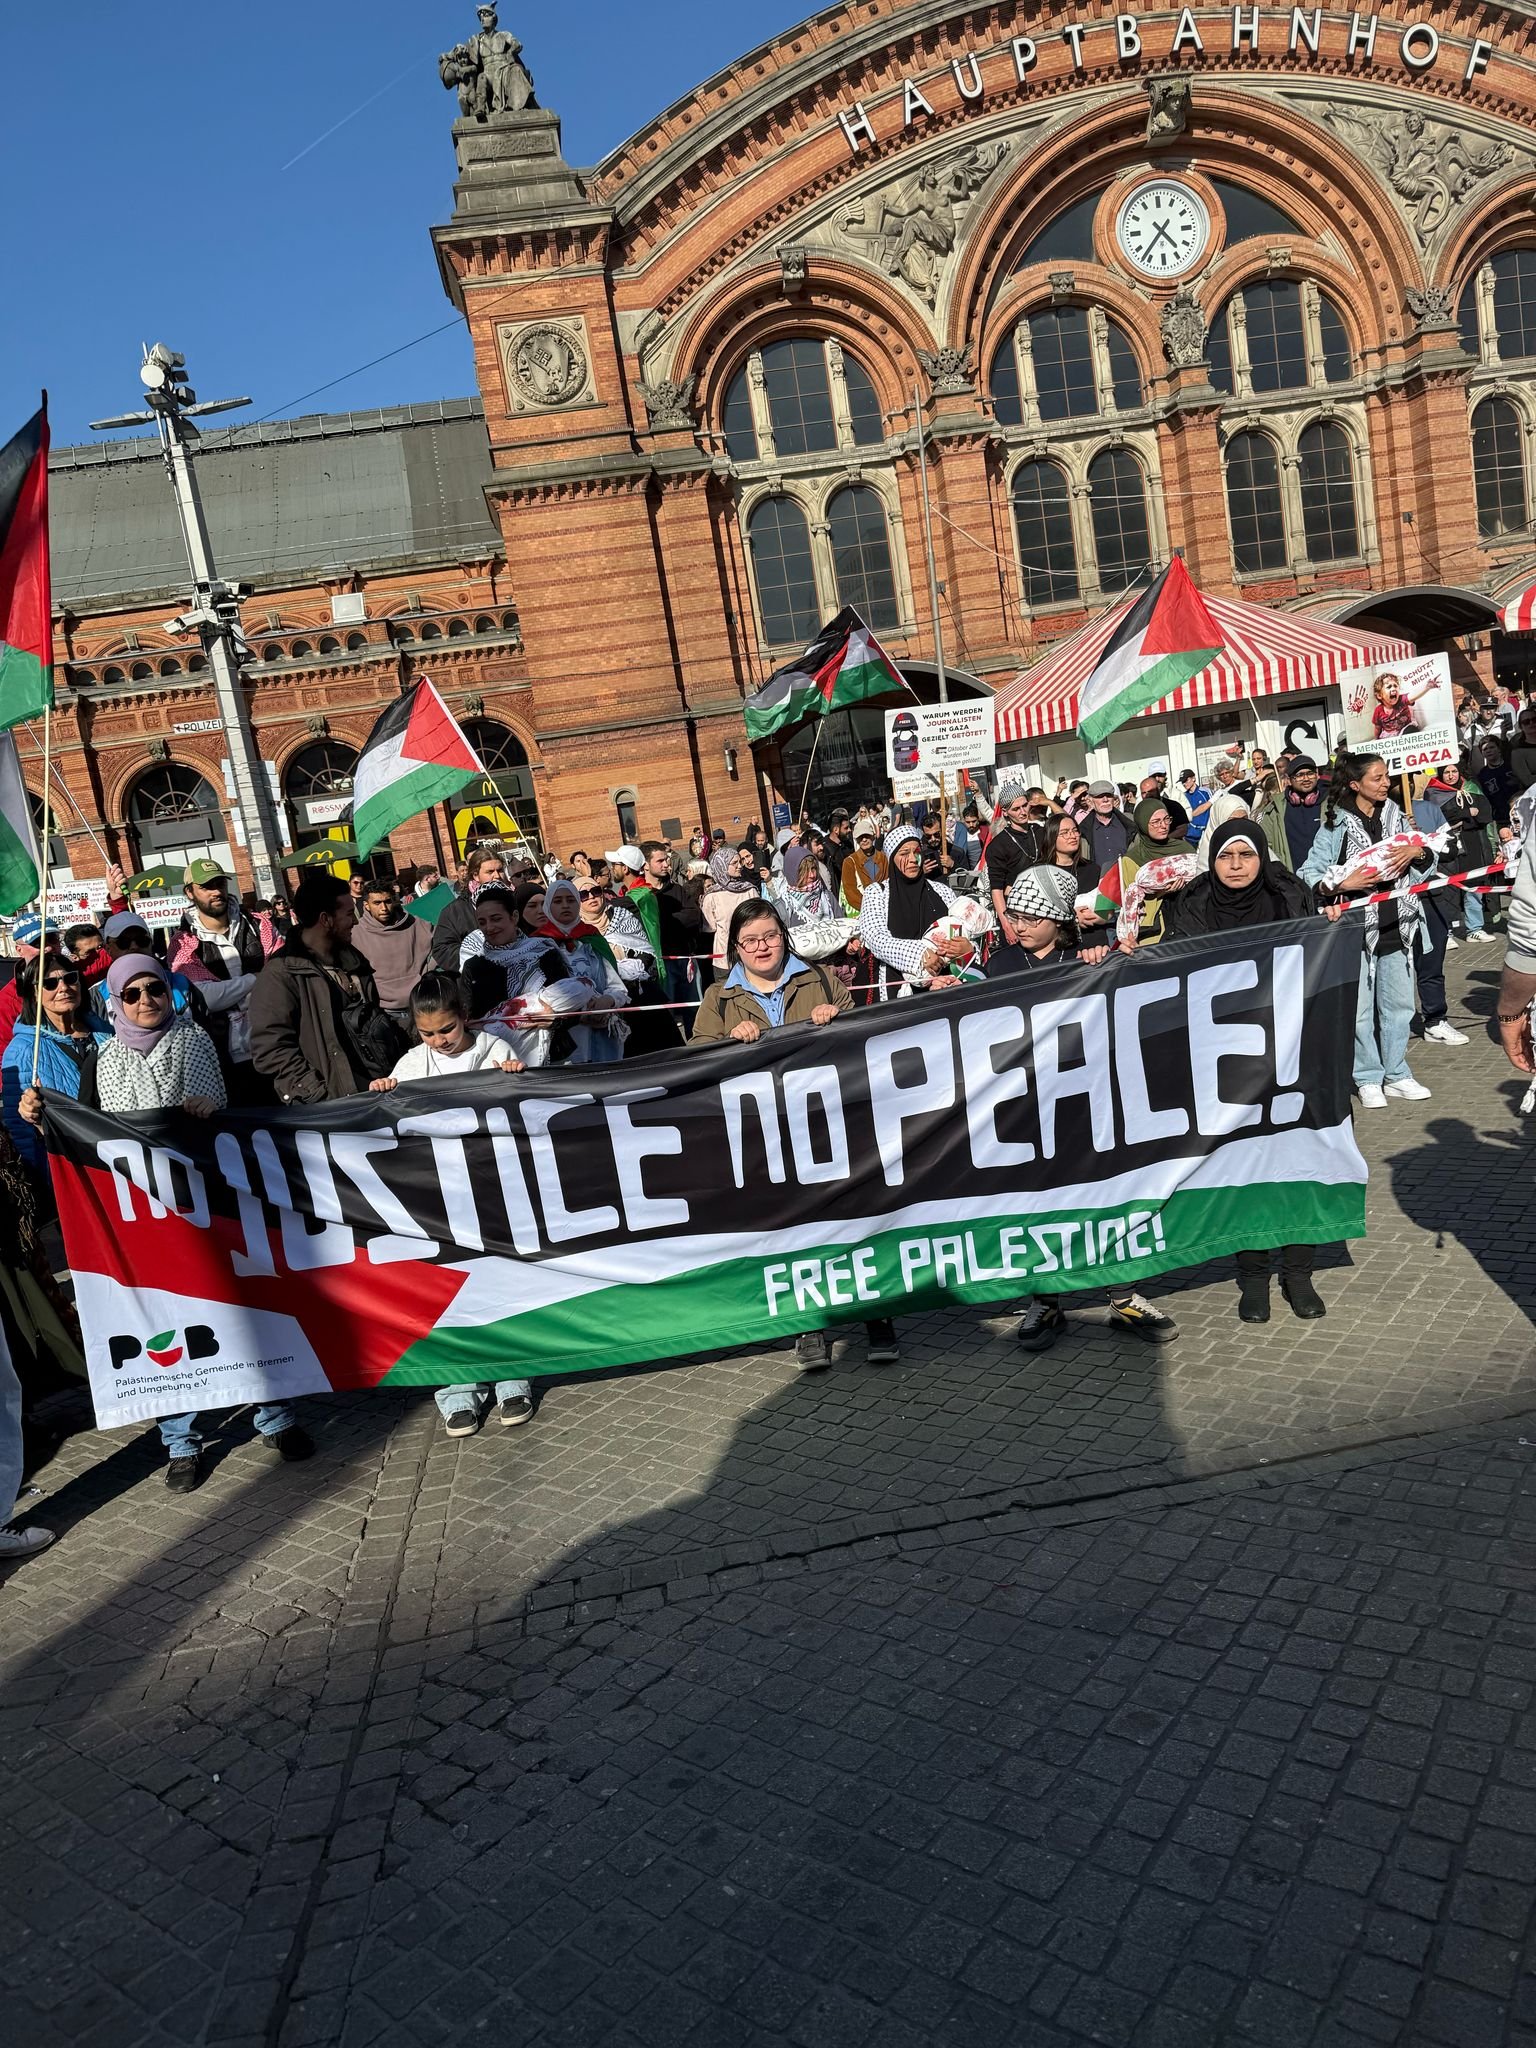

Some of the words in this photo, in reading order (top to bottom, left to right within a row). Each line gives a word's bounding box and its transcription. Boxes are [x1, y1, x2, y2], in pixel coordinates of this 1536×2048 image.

[836, 5, 1493, 154] HAUPTBAHNHOF
[1402, 659, 1435, 682] SCHÜTZT
[1411, 672, 1430, 687] MICH
[922, 711, 950, 720] WARUM
[952, 707, 983, 716] WERDEN
[926, 715, 982, 727] JOURNALISTEN
[183, 719, 222, 733] POLIZEI
[949, 724, 970, 732] GAZA
[921, 734, 950, 743] GEZIELT
[951, 729, 988, 739] GETÖTET?
[1356, 729, 1449, 753] MENSCHENRECHTE
[1381, 747, 1402, 756] ALLEN
[1402, 741, 1437, 752] MENSCHEN
[1405, 748, 1452, 767] GAZA
[41, 891, 89, 902] NDERMÖRDER
[136, 899, 170, 909] STOPPT
[171, 897, 187, 905] DEN
[58, 904, 74, 913] SIND
[215, 1086, 689, 1278] JUSTICE
[720, 1065, 851, 1189] NO
[864, 944, 1305, 1187] PEACE!
[764, 1246, 881, 1317] FREE
[898, 1210, 1166, 1293] PALESTINE!
[115, 1371, 194, 1388] Palästinensische
[195, 1361, 245, 1376] Gemeinde
[246, 1361, 255, 1369] in
[256, 1354, 295, 1368] Bremen
[117, 1387, 137, 1399] und
[138, 1381, 192, 1396] Umgebung
